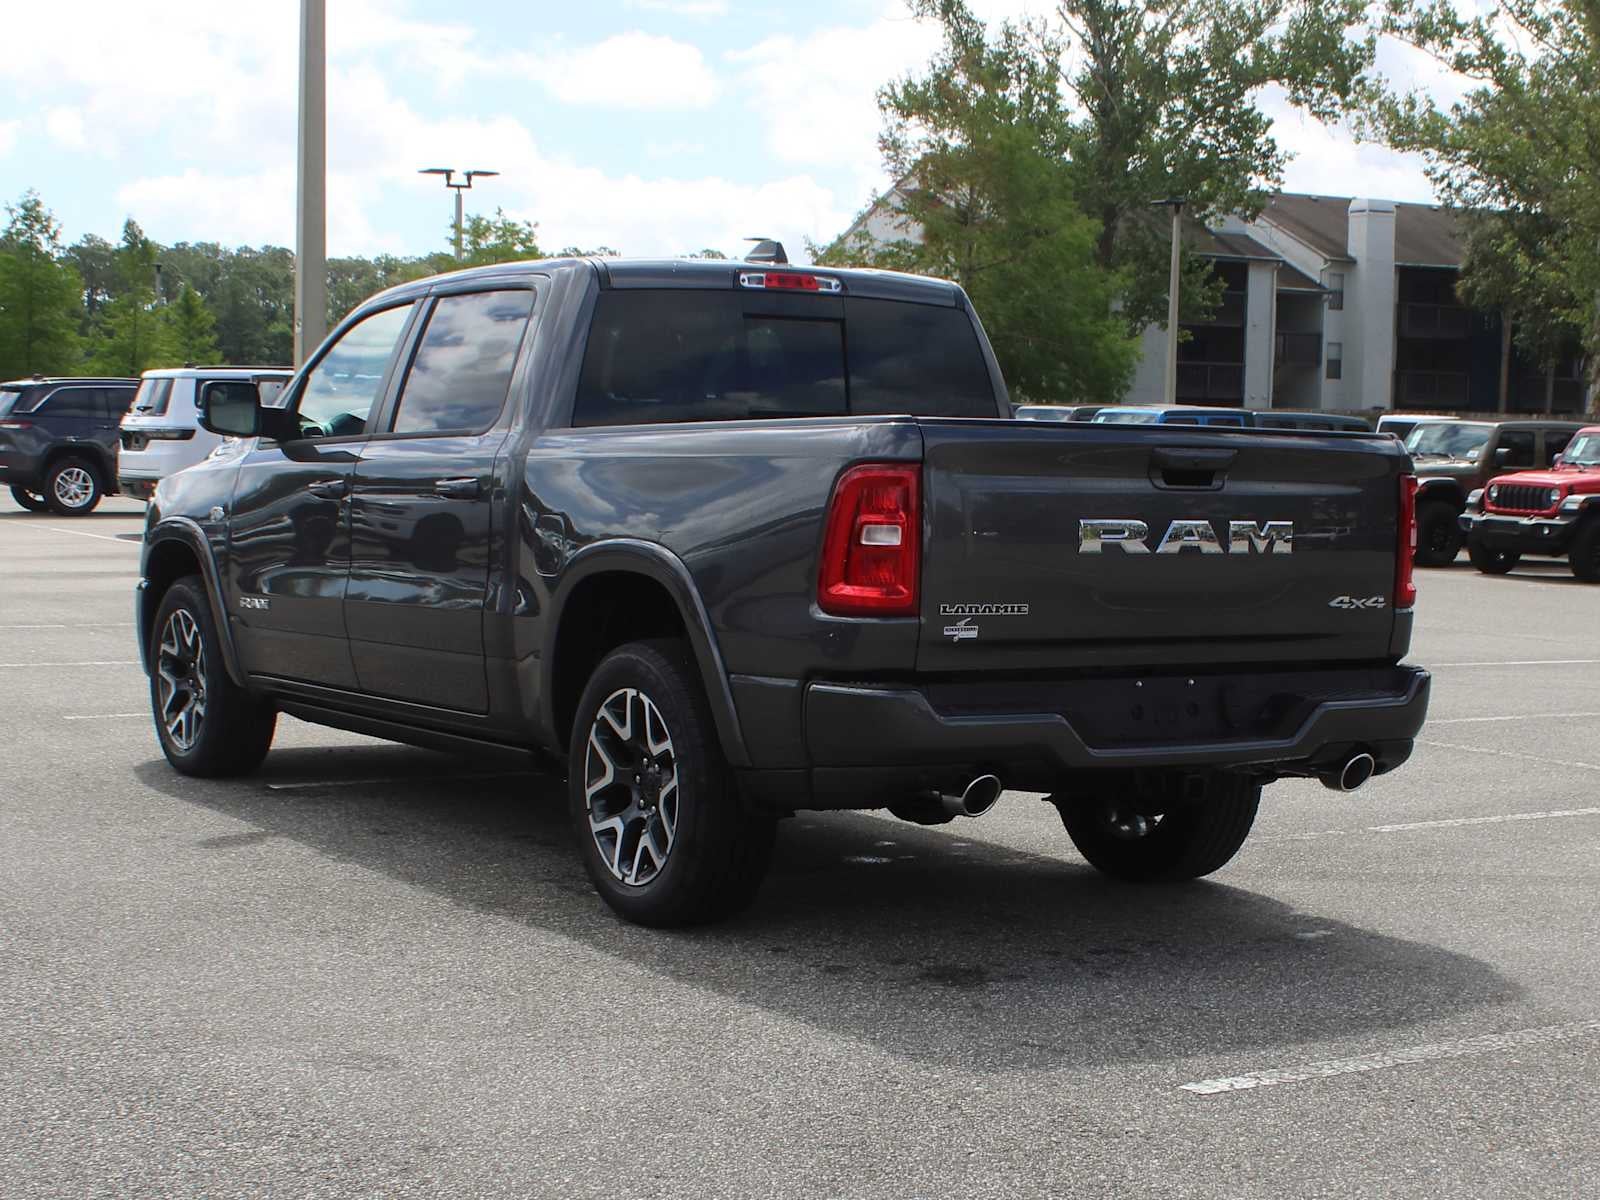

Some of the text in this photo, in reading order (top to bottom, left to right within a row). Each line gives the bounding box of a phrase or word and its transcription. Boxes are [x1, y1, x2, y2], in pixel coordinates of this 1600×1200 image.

[1078, 518, 1294, 554] RAM
[1328, 595, 1386, 609] 4x4
[940, 603, 1029, 616] LARAMIE
